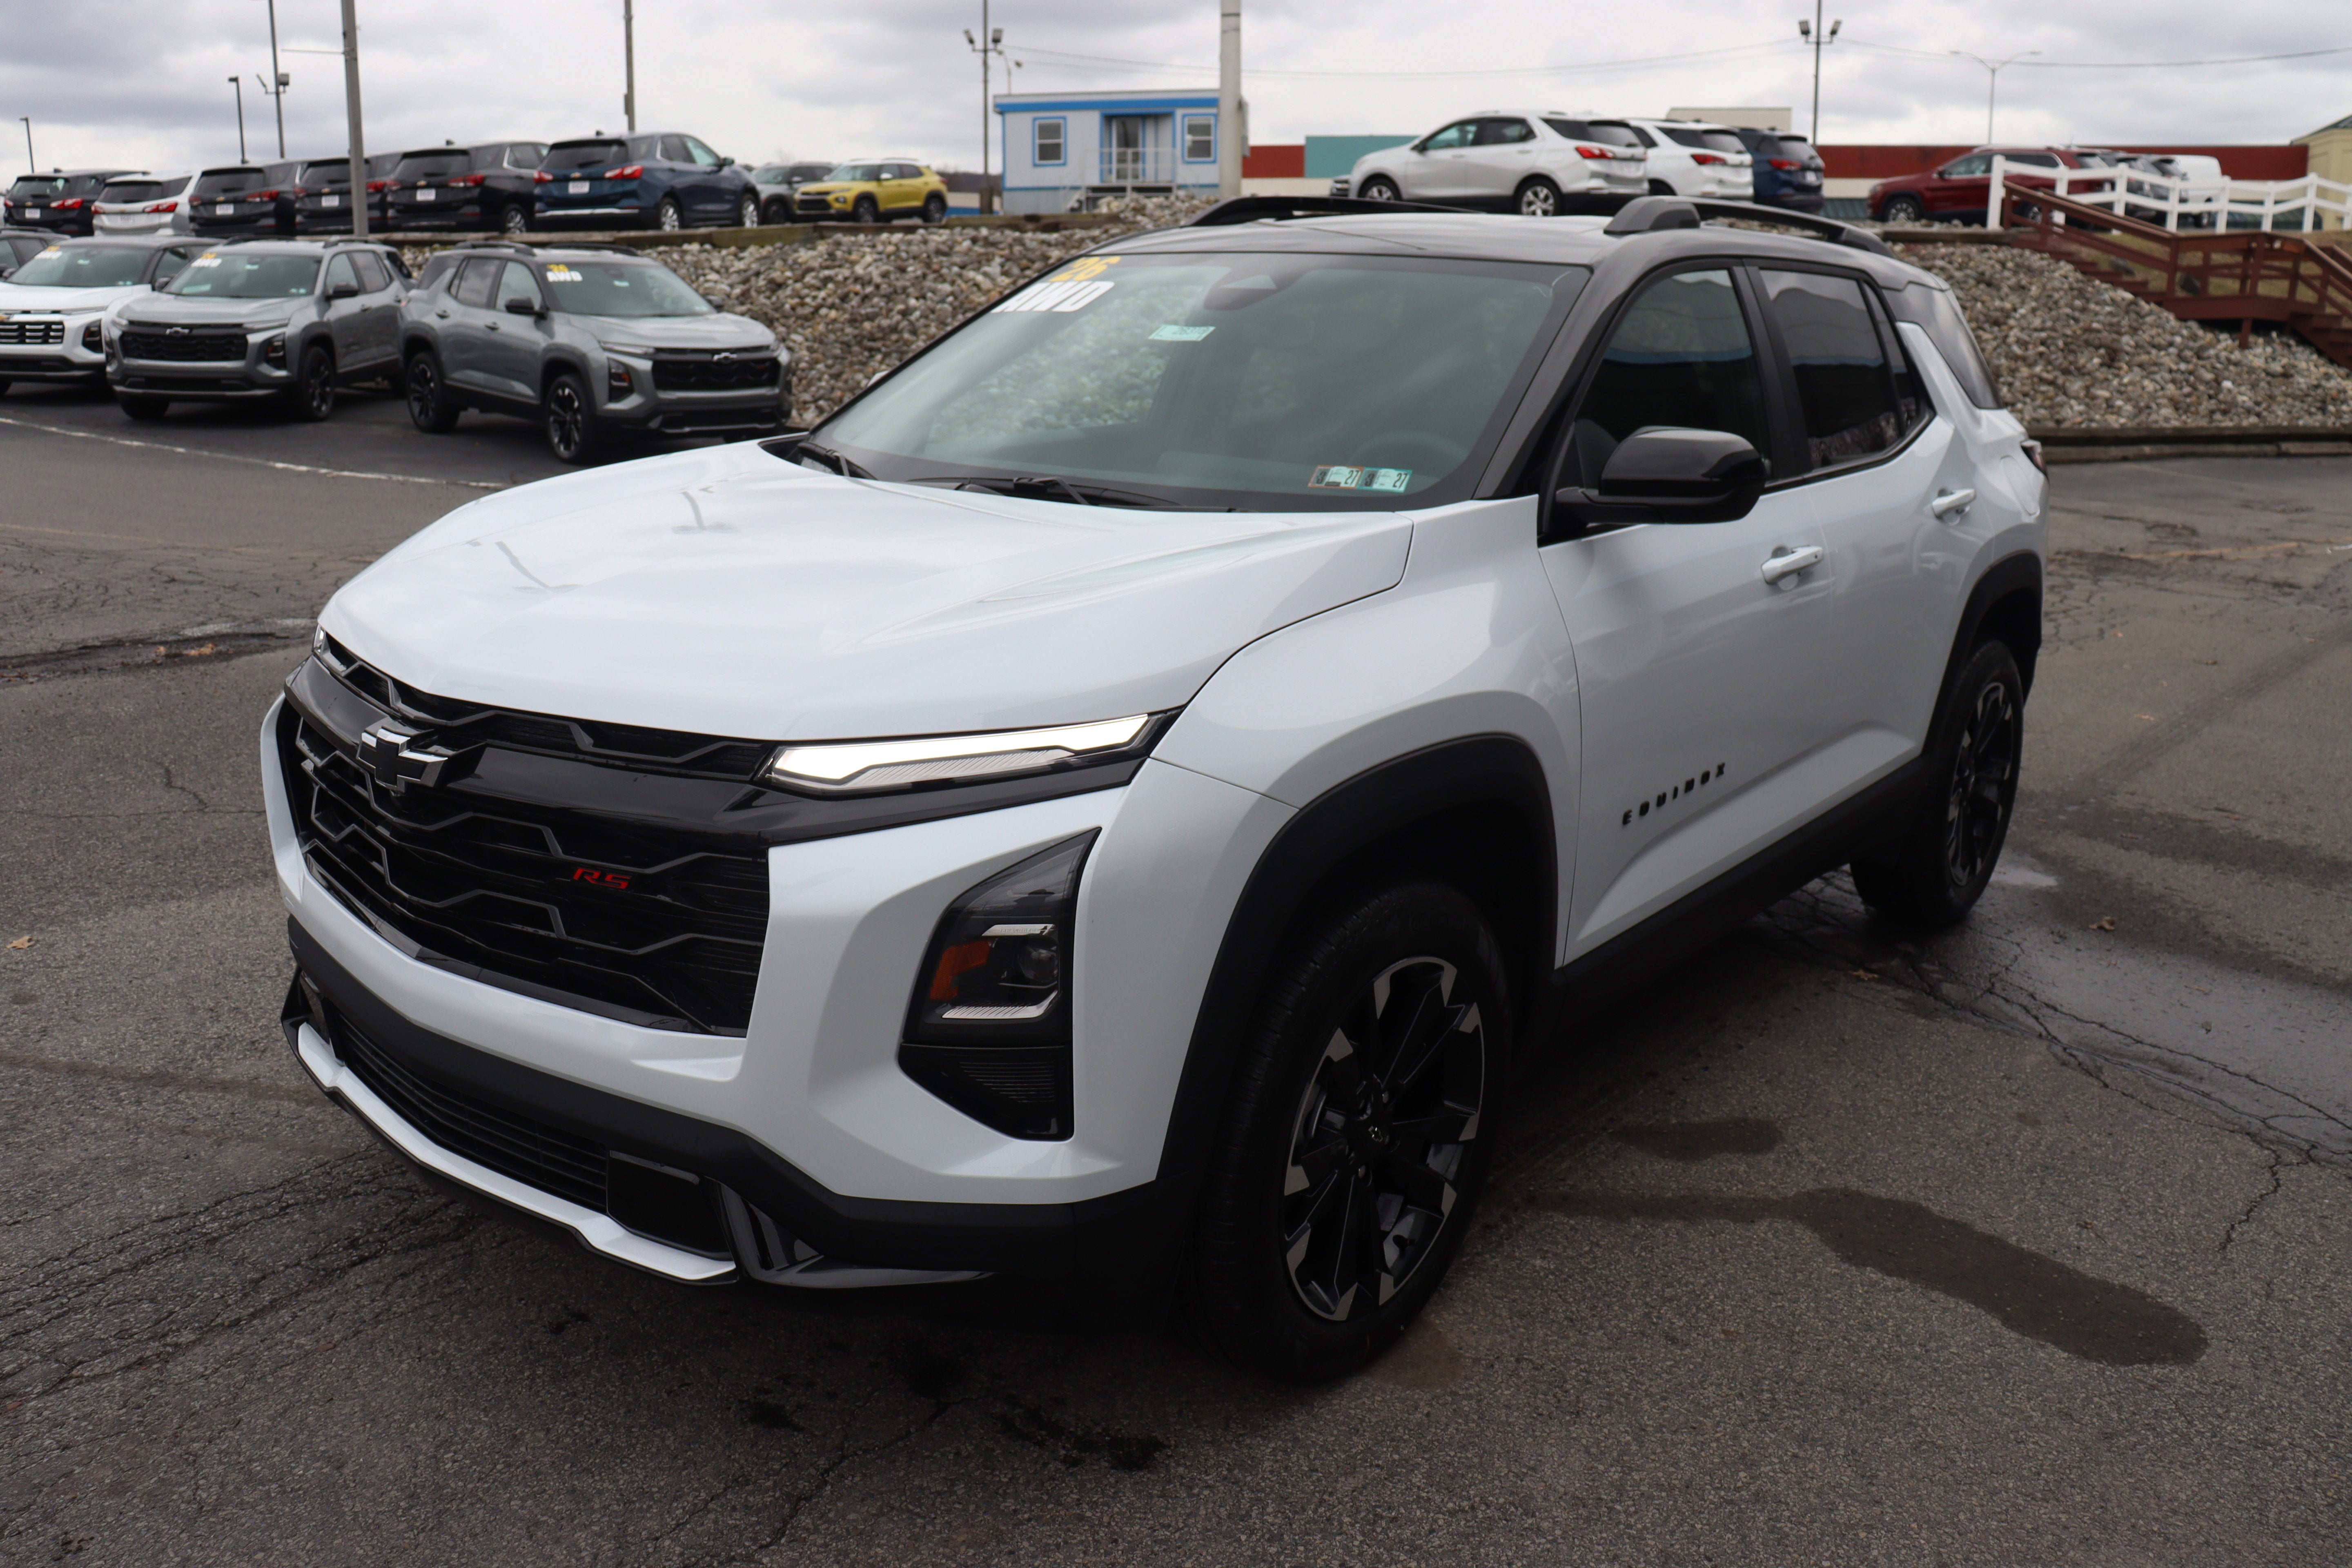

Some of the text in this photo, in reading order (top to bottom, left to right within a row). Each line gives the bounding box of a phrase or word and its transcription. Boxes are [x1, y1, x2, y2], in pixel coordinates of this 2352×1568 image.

[991, 281, 1115, 313] AWD
[1344, 470, 1360, 486] 27
[1393, 472, 1408, 489] 27
[1622, 762, 1726, 825] EQUINOX
[573, 868, 631, 889] RS
